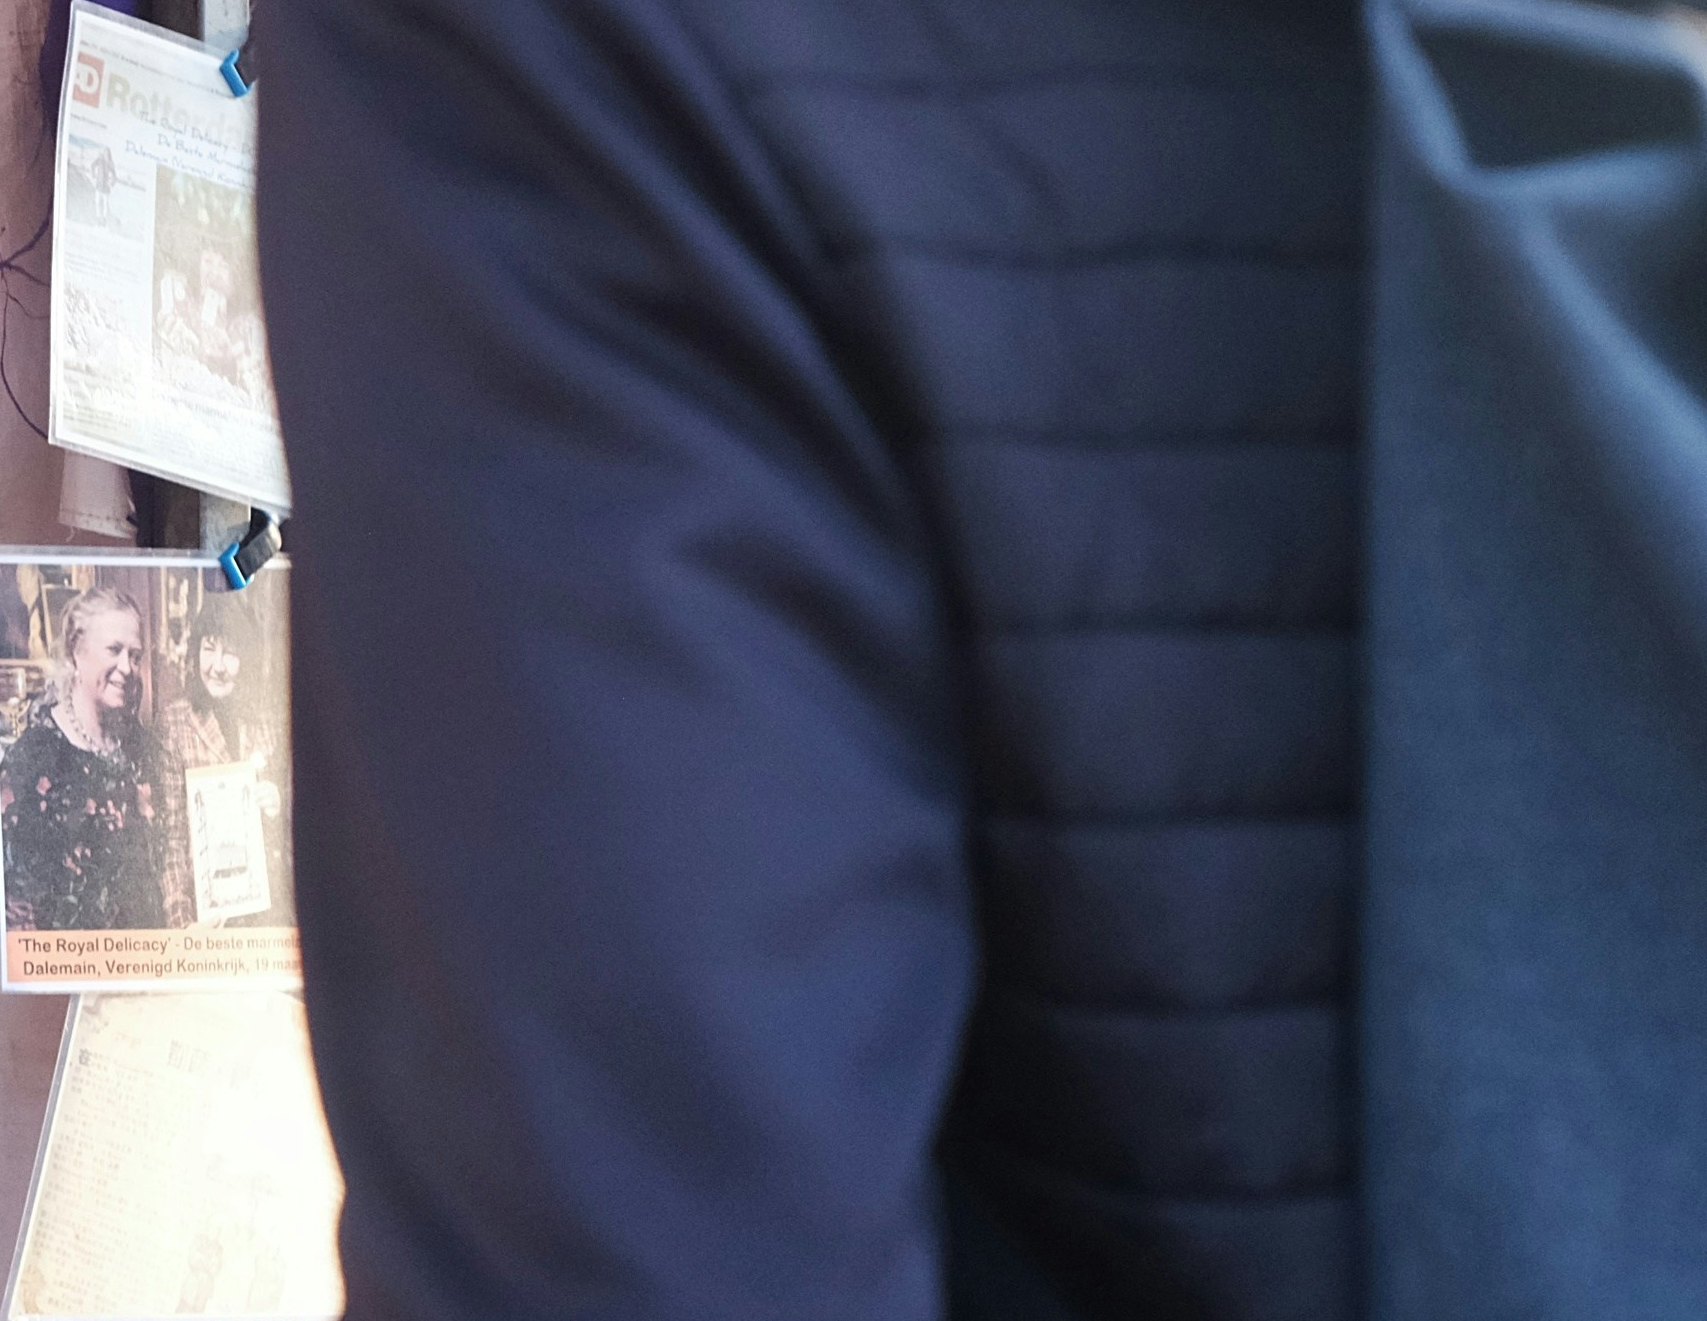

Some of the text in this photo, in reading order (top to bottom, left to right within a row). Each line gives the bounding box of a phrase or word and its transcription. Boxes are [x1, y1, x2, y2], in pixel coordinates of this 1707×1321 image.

[55, 937, 100, 956] Royal
[183, 936, 202, 951] De
[205, 935, 243, 950] beste
[23, 956, 269, 979] Dalemain, Verenigd Koninkrijk, 19
